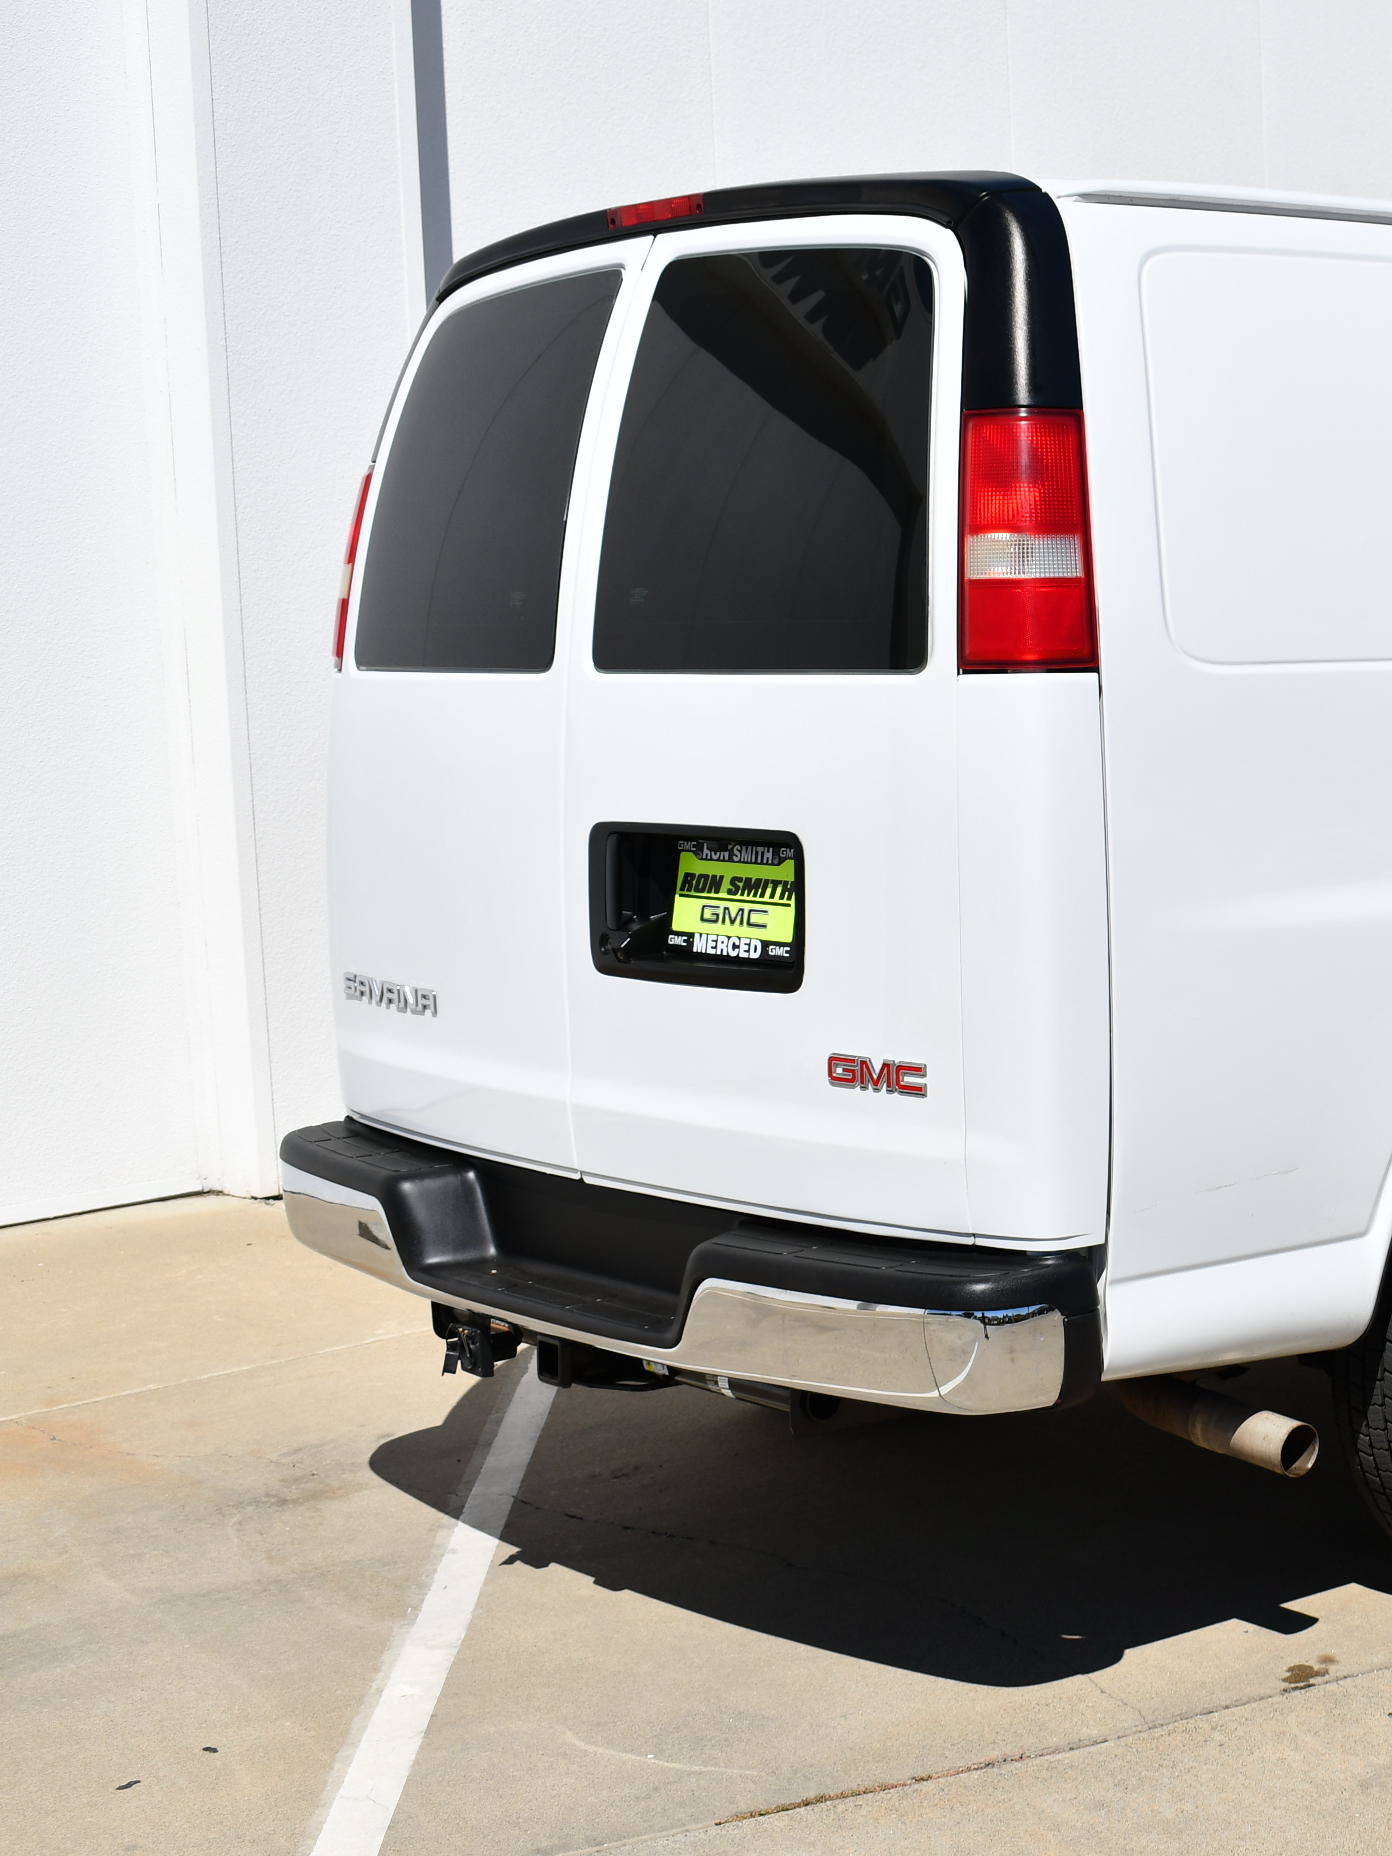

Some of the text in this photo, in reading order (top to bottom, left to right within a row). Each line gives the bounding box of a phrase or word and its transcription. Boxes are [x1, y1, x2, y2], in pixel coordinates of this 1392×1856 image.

[678, 841, 697, 851] GMC
[732, 845, 773, 864] SMITH
[779, 847, 794, 858] GM
[680, 872, 796, 901] RON SMITH
[700, 904, 769, 930] GMC
[668, 932, 790, 959] GMC MERCED GMC
[343, 971, 438, 1018] SAVANA
[827, 1052, 928, 1099] GMC
